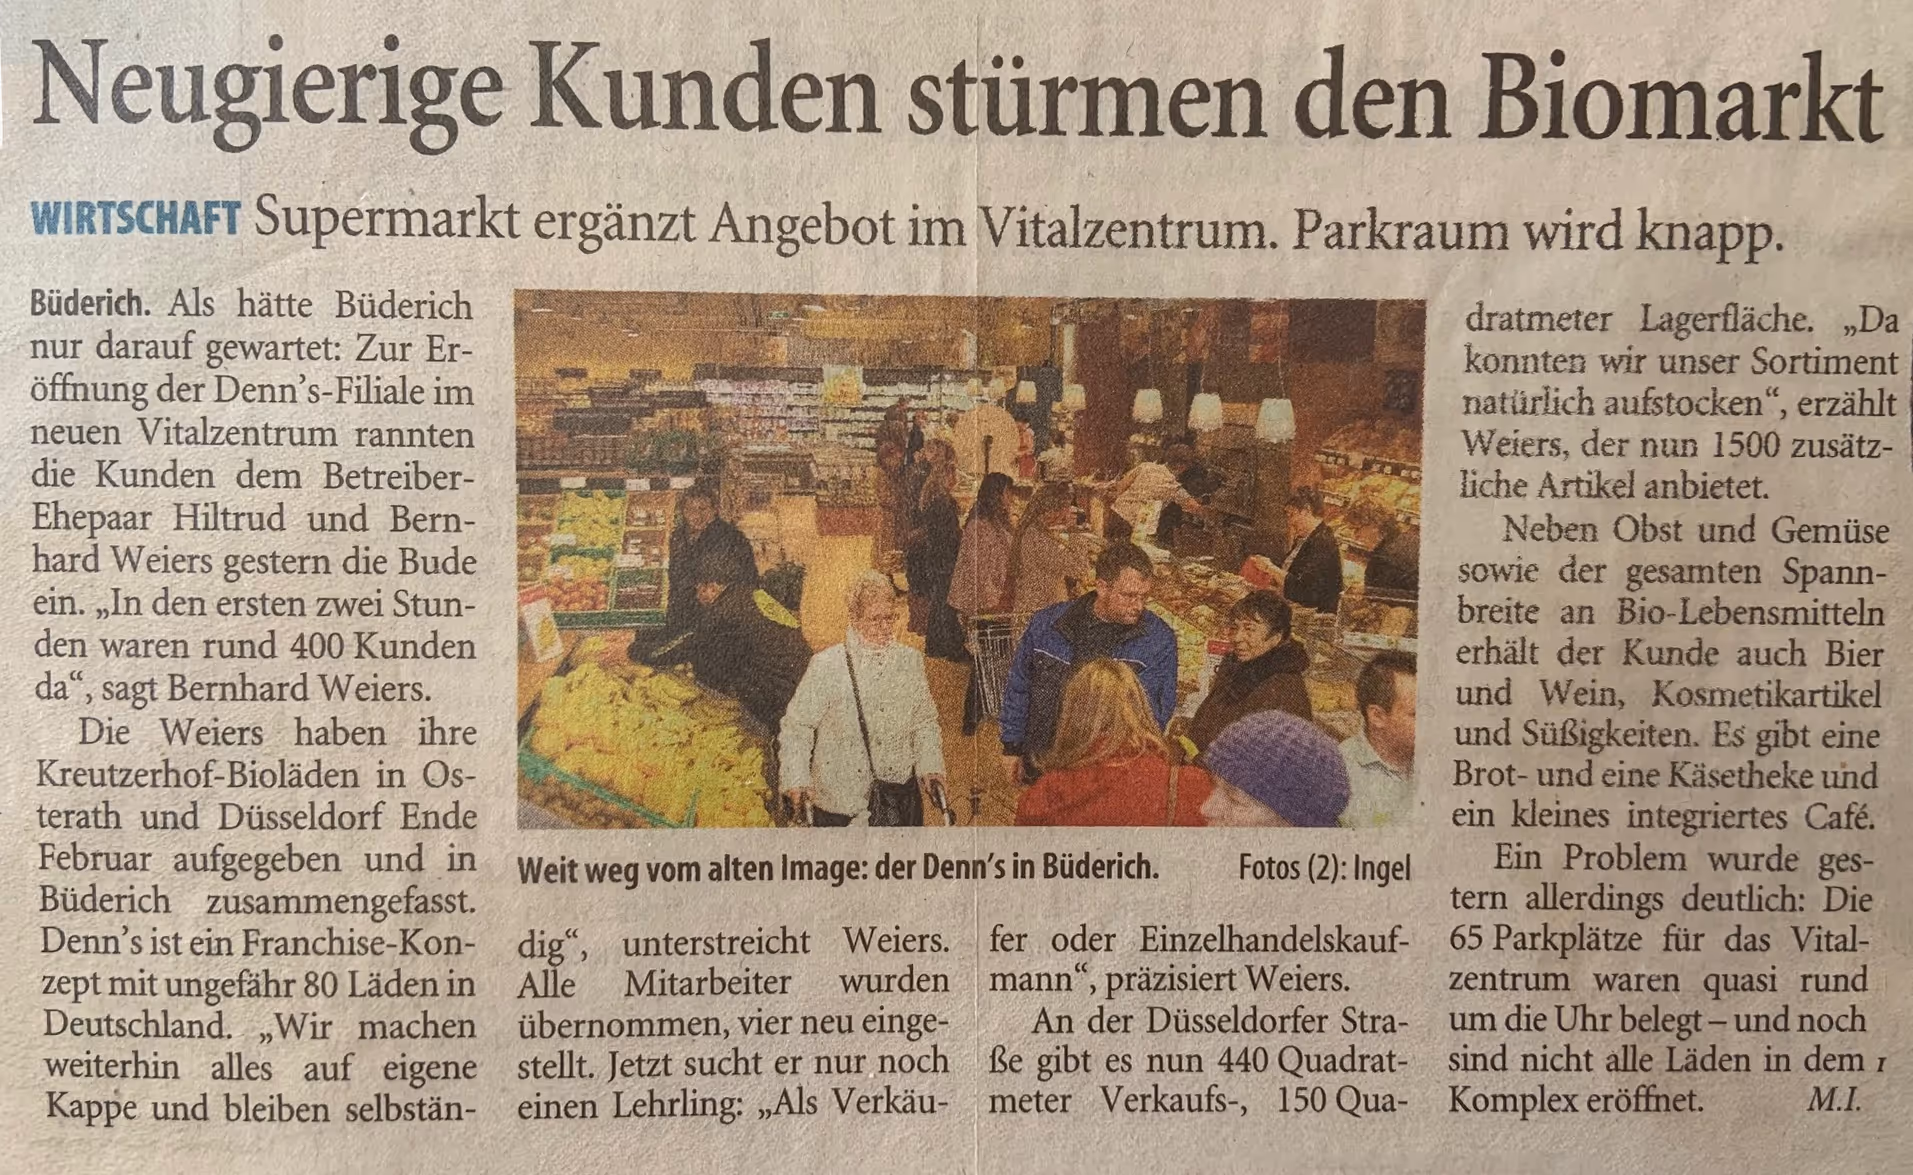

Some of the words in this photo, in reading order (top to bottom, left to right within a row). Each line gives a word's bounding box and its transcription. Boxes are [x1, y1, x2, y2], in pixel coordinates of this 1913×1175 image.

[31, 33, 506, 157] Neugierige
[528, 37, 883, 134] Kunden
[907, 54, 1269, 139] stürmen
[1294, 43, 1453, 140] den
[1477, 48, 1885, 144] Biomarkt
[30, 199, 242, 235] WIRTSCHAFT
[255, 192, 522, 250] Supermarkt
[533, 202, 697, 255] ergänzt
[707, 200, 896, 258] Angebot
[908, 203, 967, 247] im
[977, 203, 1279, 250] Vitalzentrum.
[1292, 205, 1510, 251] Parkraum
[1522, 206, 1624, 251] wird
[1634, 206, 1784, 265] knapp.
[30, 287, 151, 317] Büderich.
[167, 286, 215, 318] Als
[236, 286, 313, 319] hätte
[334, 288, 475, 321] Büderich
[1465, 299, 1614, 333] dratmeter
[1639, 301, 1814, 342] Lagerfläche.
[1463, 341, 1587, 375] konnten
[1597, 344, 1648, 375] wir
[1658, 353, 1741, 375] unser
[1750, 345, 1900, 376] Sortiment
[29, 370, 149, 412] öffnung
[156, 371, 206, 403] der
[432, 375, 475, 406] im
[30, 456, 76, 488] die
[94, 457, 217, 489] Kunden
[235, 457, 303, 490] dem
[322, 459, 475, 491] Betreiber-
[1459, 468, 1529, 500] liche
[1535, 468, 1636, 500] Artikel
[1644, 468, 1770, 500] anbietet.
[1457, 555, 1540, 584] sowie
[1558, 553, 1608, 584] der
[1625, 560, 1763, 593] gesamten
[1782, 556, 1888, 594] Spann-
[32, 585, 86, 616] ein.
[151, 585, 208, 617] den
[215, 592, 308, 618] ersten
[315, 587, 385, 618] zwei
[392, 588, 476, 618] Stun-
[1455, 635, 1540, 666] erhält
[1556, 635, 1605, 668] der
[1621, 636, 1720, 668] Kunde
[1736, 637, 1808, 668] auch
[1824, 638, 1885, 668] Bier
[101, 677, 159, 711] sagt
[166, 671, 311, 703] Bernhard
[316, 672, 432, 702] Weiers.
[1453, 716, 1513, 747] und
[1521, 717, 1700, 755] Süßigkeiten.
[1711, 720, 1745, 749] Es
[1755, 718, 1812, 757] gibt
[1821, 720, 1881, 749] eine
[35, 757, 361, 789] Kreutzerhof-Bioläden
[375, 759, 407, 789] in
[422, 759, 477, 789] Os-
[1451, 799, 1496, 828] ein
[1510, 797, 1610, 829] kleines
[1626, 800, 1789, 838] integriertes
[1804, 801, 1875, 831] Café.
[38, 840, 153, 872] Februar
[173, 841, 343, 882] aufgegeben
[363, 841, 426, 873] und
[446, 842, 478, 873] in
[517, 855, 579, 885] Weit
[583, 862, 640, 891] weg
[645, 860, 702, 883] vom
[707, 853, 774, 883] alten
[781, 853, 869, 888] Image:
[874, 851, 917, 881] der
[1012, 851, 1036, 880] in
[1042, 850, 1160, 880] Büderich.
[1239, 852, 1301, 881] Fotos
[1308, 852, 1347, 885] (2):
[1354, 852, 1411, 888] Ingel
[1449, 886, 1509, 911] tern
[1525, 881, 1664, 921] allerdings
[1681, 882, 1805, 913] deutlich:
[1822, 884, 1874, 913] Die
[149, 926, 184, 957] ist
[189, 927, 235, 957] ein
[241, 925, 476, 957] Franchise-Kon-
[622, 924, 812, 958] unterstreicht
[841, 924, 950, 954] Weiers.
[989, 923, 1029, 953] fer
[1051, 922, 1117, 953] oder
[1138, 922, 1410, 954] Einzelhandelskauf-
[41, 971, 103, 1004] zept
[107, 967, 159, 997] mit
[164, 967, 297, 1007] ungefähr
[303, 970, 339, 999] 80
[347, 967, 440, 999] Läden
[446, 968, 477, 998] in
[517, 967, 577, 999] Alle
[623, 965, 793, 998] Mitarbeiter
[838, 963, 951, 994] wurden
[1104, 963, 1238, 1001] präzisiert
[1243, 963, 1351, 993] Weiers.
[517, 1009, 730, 1041] übernommen,
[737, 1007, 794, 1036] vier
[799, 1014, 855, 1036] neu
[861, 1004, 949, 1043] einge-
[1030, 1006, 1075, 1035] An
[1087, 1004, 1134, 1035] der
[1145, 1003, 1329, 1035] Düsseldorfer
[1340, 1005, 1409, 1035] Stra-
[42, 1049, 181, 1080] weiterhin
[211, 1051, 273, 1082] alles
[303, 1051, 356, 1083] auf
[382, 1052, 478, 1090] eigene
[517, 1049, 595, 1081] stellt.
[606, 1050, 673, 1085] Jetzt
[684, 1046, 764, 1077] sucht
[774, 1055, 804, 1076] er
[813, 1054, 867, 1075] nur
[877, 1042, 951, 1076] noch
[988, 1044, 1024, 1076] ße
[1036, 1043, 1092, 1083] gibt
[1105, 1053, 1133, 1074] es
[1145, 1053, 1205, 1074] nun
[1216, 1046, 1269, 1074] 440
[1277, 1043, 1409, 1079] Quadrat-
[1448, 1042, 1509, 1073] sind
[1519, 1042, 1594, 1073] nicht
[1605, 1043, 1654, 1073] alle
[1664, 1043, 1752, 1073] Läden
[1763, 1044, 1792, 1073] in
[1803, 1043, 1864, 1073] dem
[517, 1091, 600, 1121] einen
[612, 1087, 744, 1126] Lehrling:
[830, 1084, 949, 1115] Verkäu-
[988, 1089, 1073, 1115] meter
[1098, 1082, 1248, 1118] Verkaufs-,
[1278, 1085, 1327, 1114] 150
[1335, 1084, 1409, 1119] Qua-
[1447, 1083, 1580, 1122] Komplex
[1586, 1083, 1704, 1114] eröffnet.
[1806, 1085, 1861, 1112] M.I.
